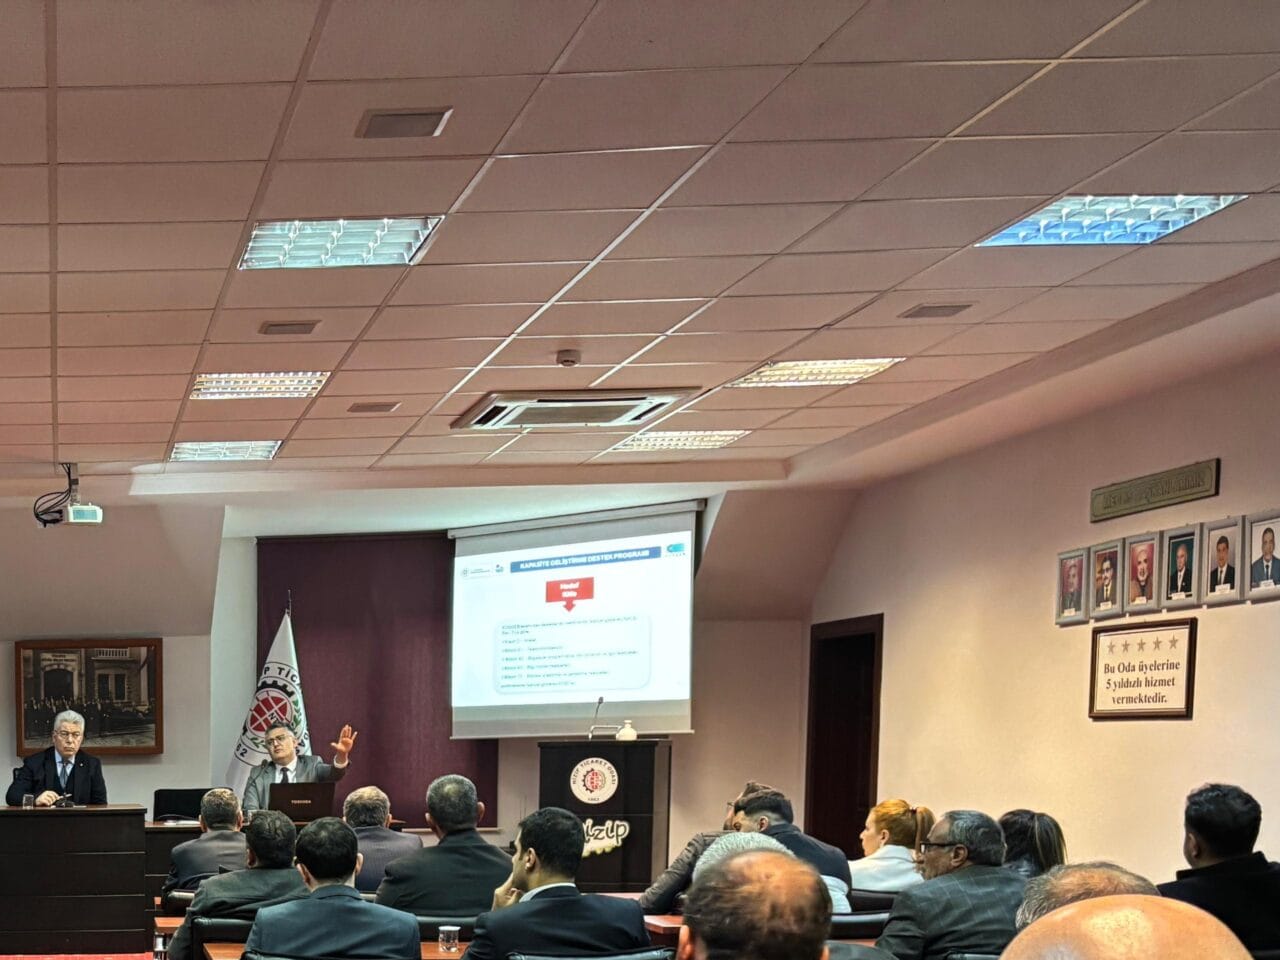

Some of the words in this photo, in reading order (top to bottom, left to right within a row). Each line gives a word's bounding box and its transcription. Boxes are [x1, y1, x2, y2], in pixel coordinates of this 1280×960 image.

[1104, 663, 1115, 674] Bu
[1117, 661, 1136, 673] Oda
[1138, 659, 1181, 675] üyelerine
[1106, 678, 1111, 689] 5
[1144, 676, 1175, 688] hizmet
[1112, 692, 1167, 704] vermektedir.
[584, 819, 628, 846] izip
